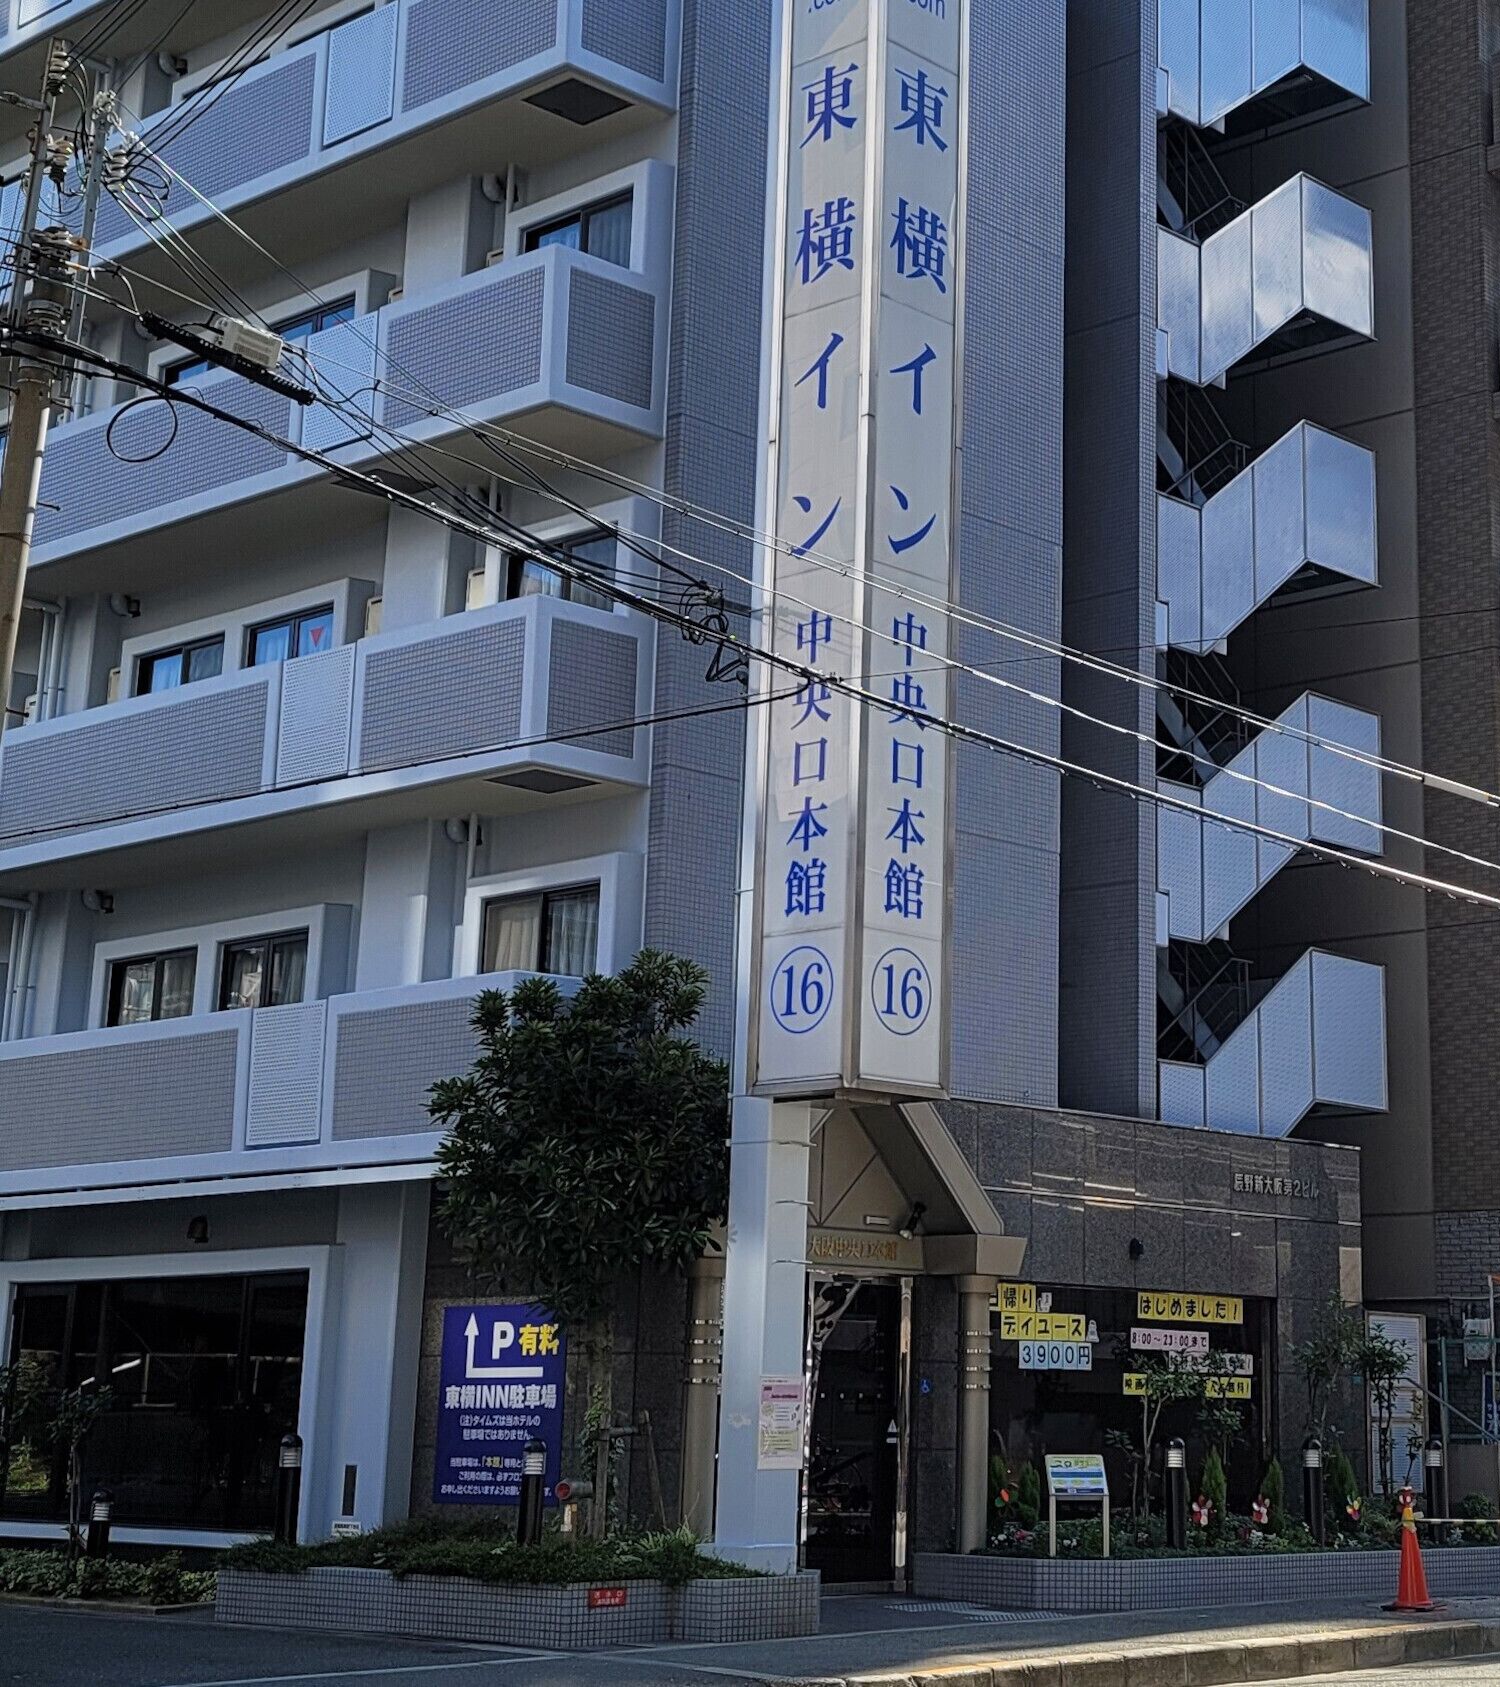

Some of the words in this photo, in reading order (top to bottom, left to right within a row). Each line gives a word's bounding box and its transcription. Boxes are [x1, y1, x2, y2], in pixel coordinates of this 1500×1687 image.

[793, 63, 857, 558] 東横イン
[889, 68, 948, 555] 東横イン
[784, 611, 832, 918] 中央口本館
[884, 612, 928, 919] 中央口本館
[444, 1383, 557, 1410] 東横INN駐車場
[492, 1321, 515, 1360] P
[518, 1323, 560, 1356] 有料
[1022, 1345, 1090, 1365] 3900円
